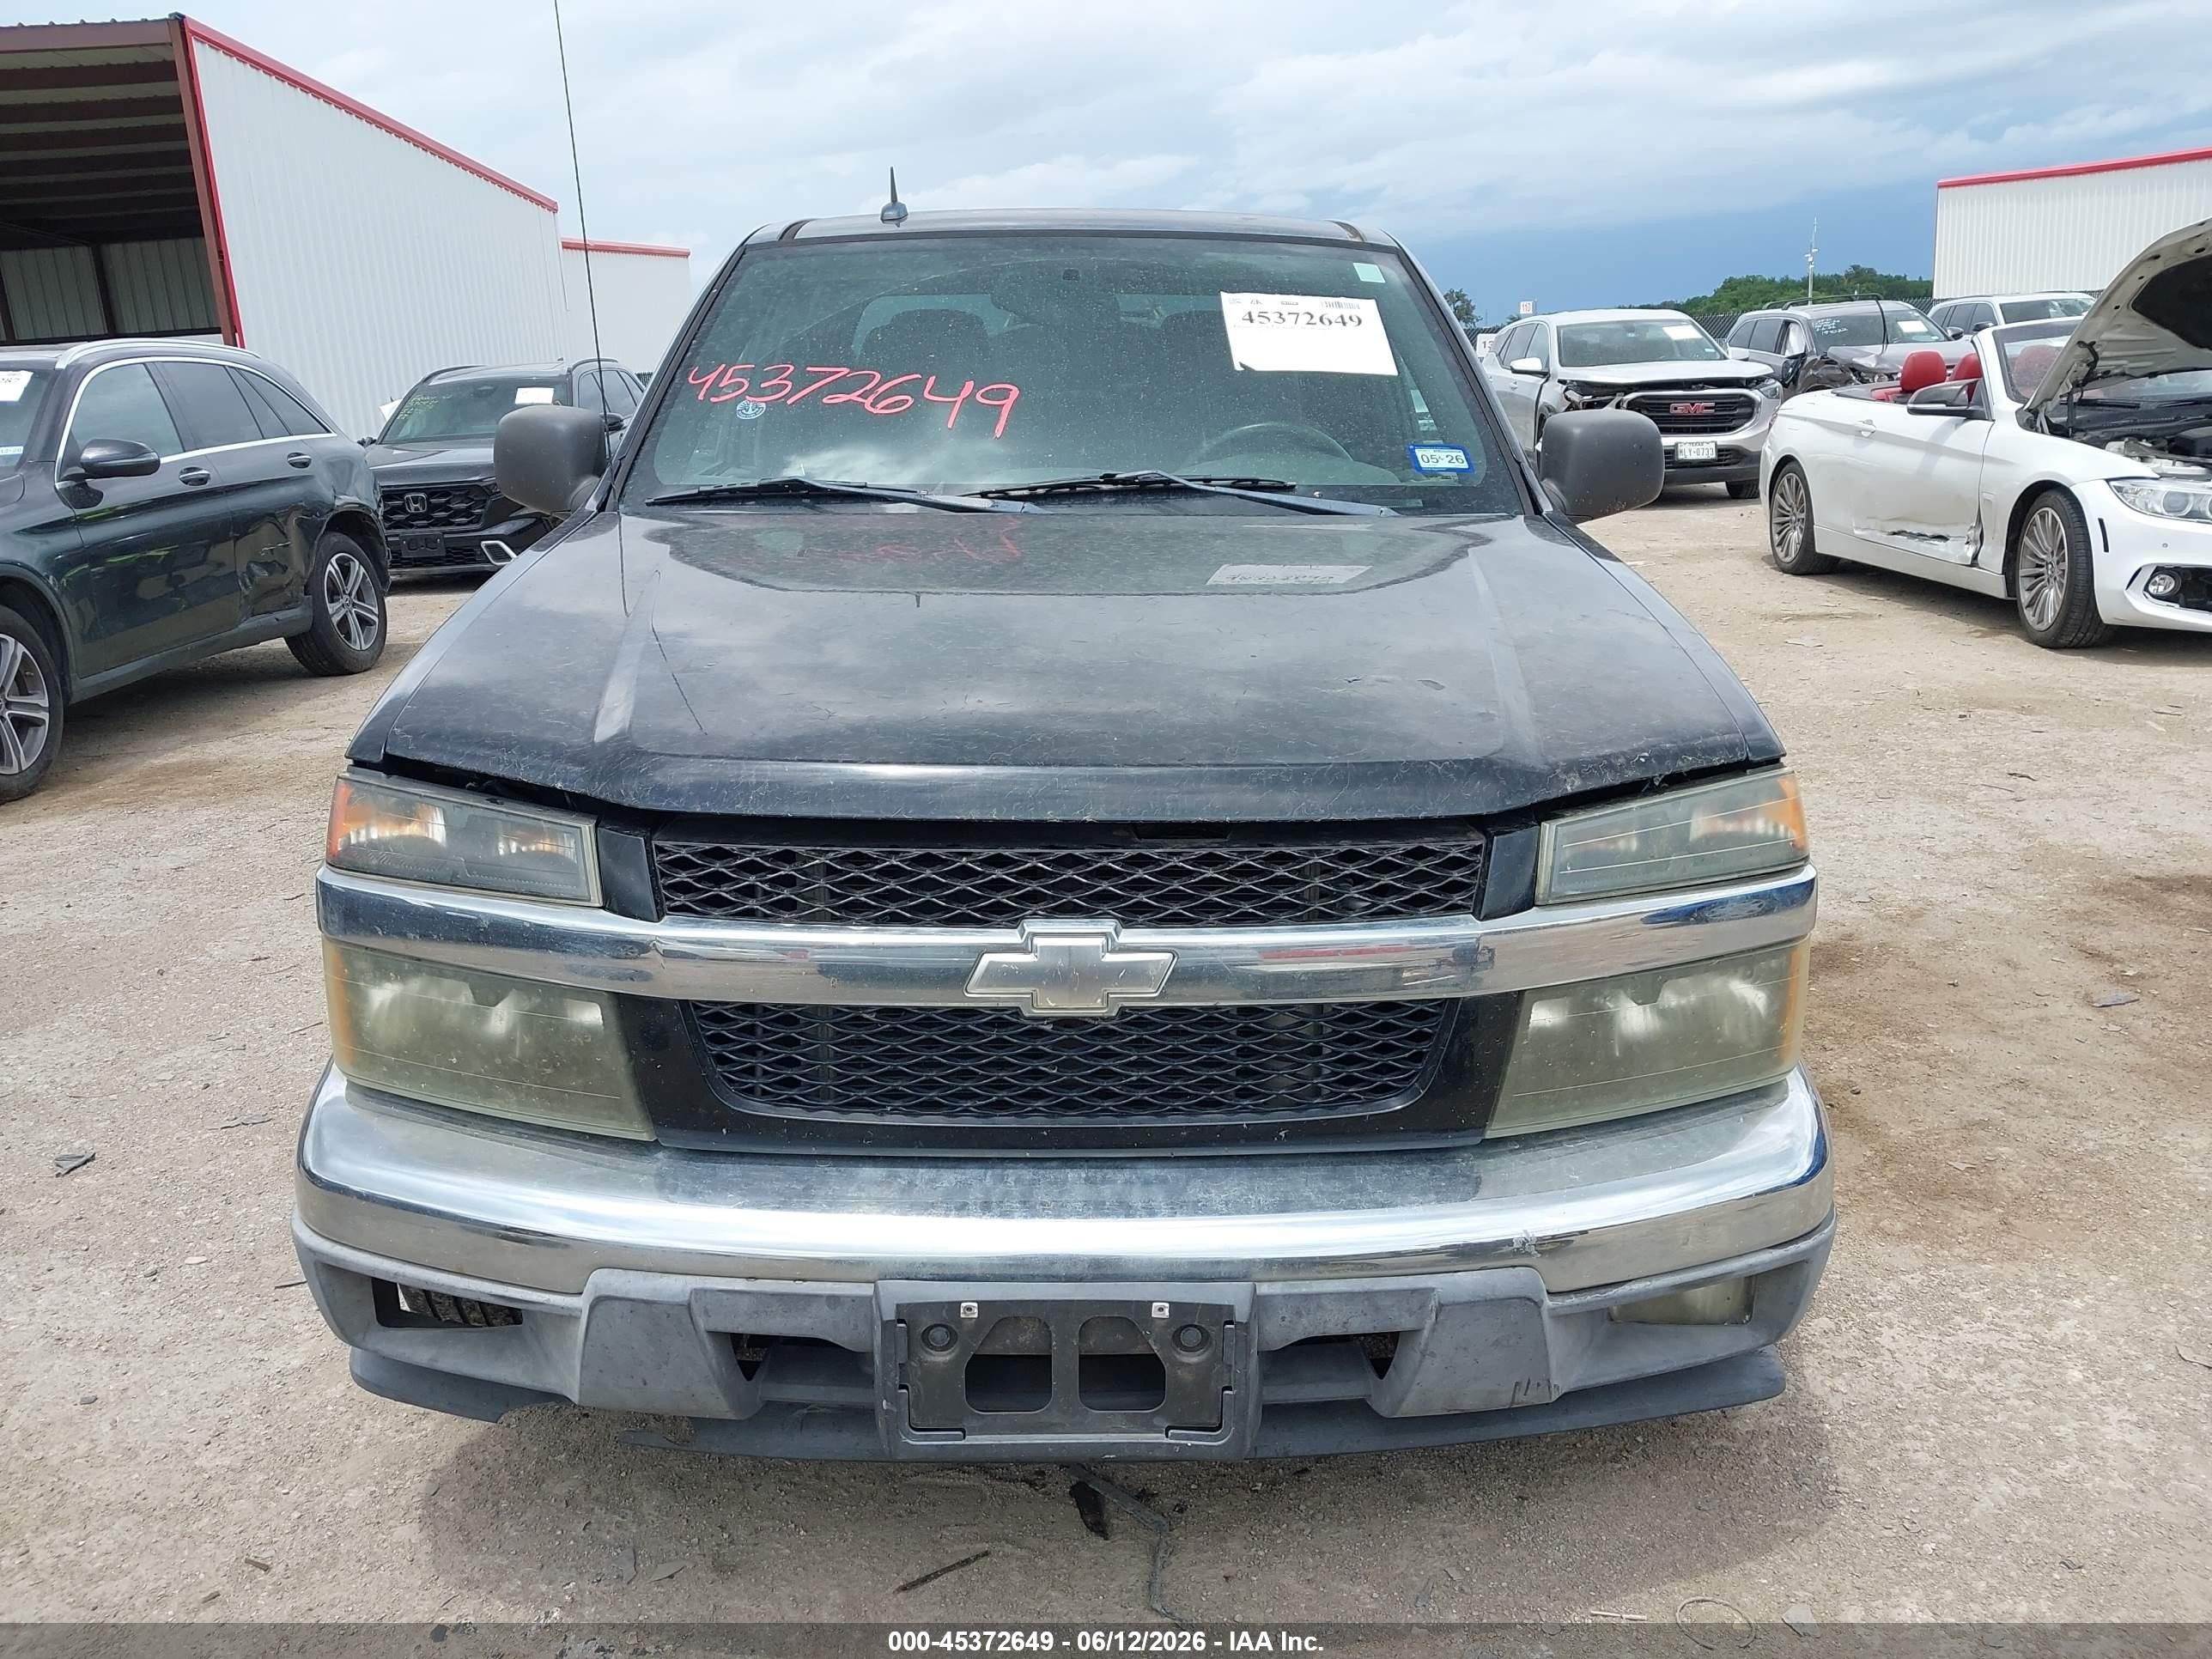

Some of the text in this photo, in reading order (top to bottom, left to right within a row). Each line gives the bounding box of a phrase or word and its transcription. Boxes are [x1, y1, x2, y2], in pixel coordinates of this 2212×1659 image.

[1242, 310, 1362, 327] 45372649
[688, 363, 1019, 439] 45372649
[1670, 402, 1716, 414] GMC
